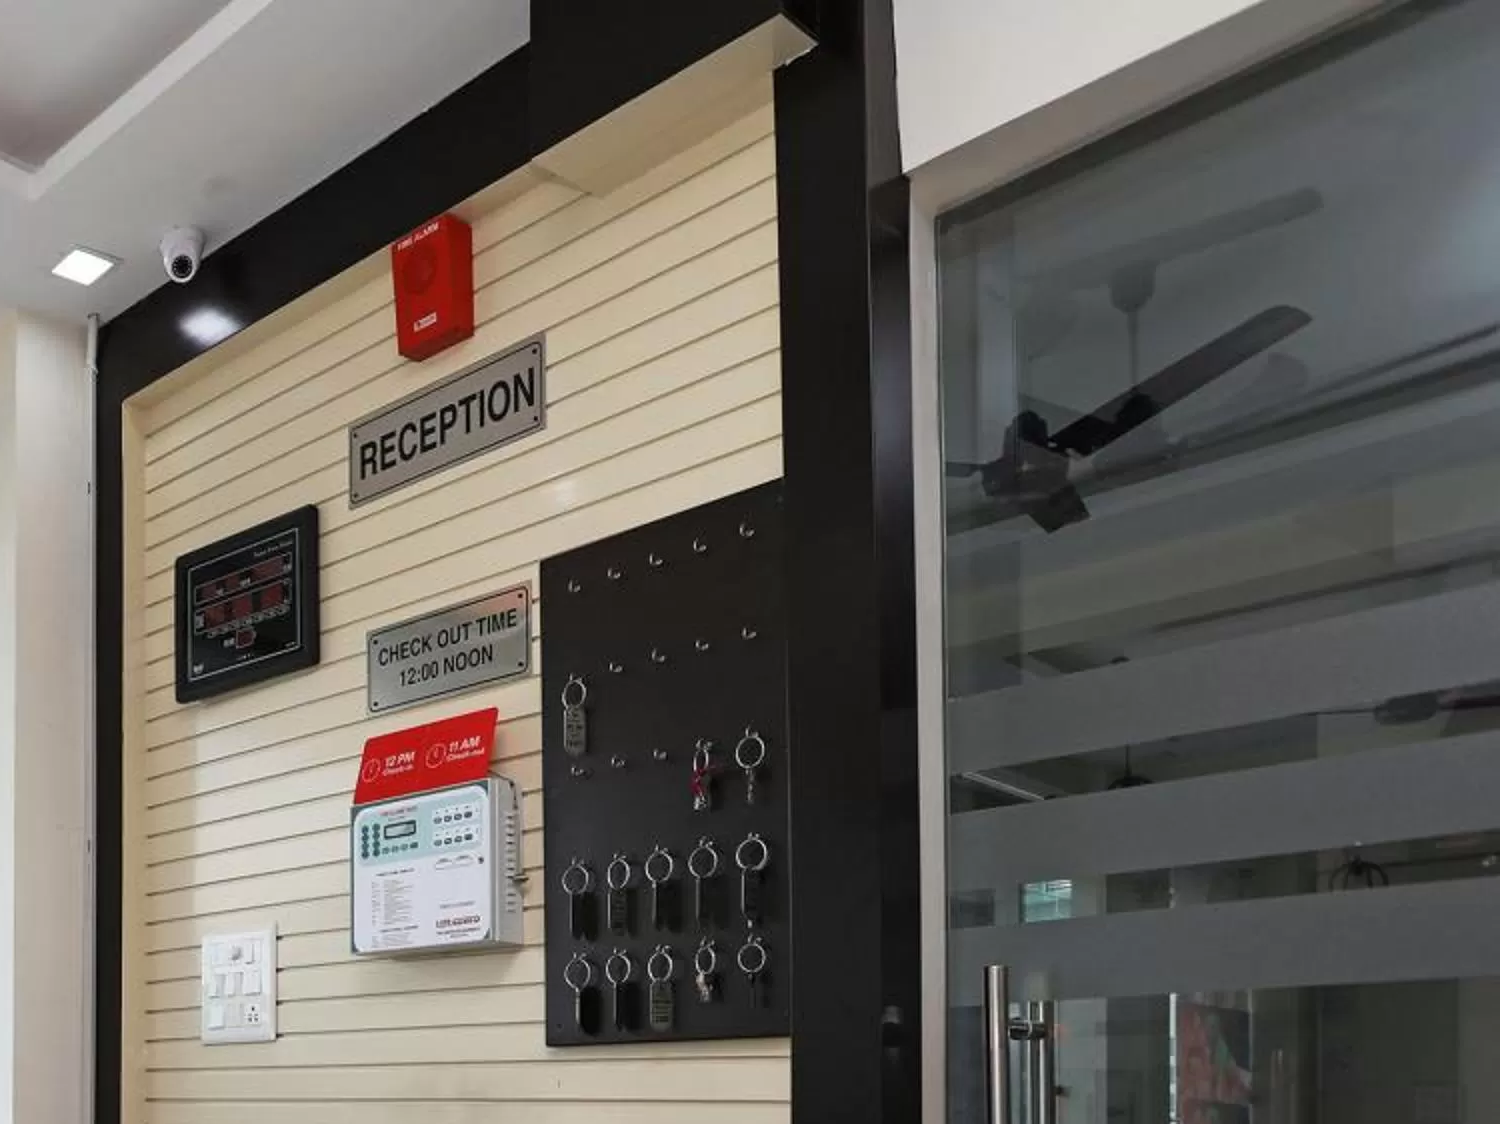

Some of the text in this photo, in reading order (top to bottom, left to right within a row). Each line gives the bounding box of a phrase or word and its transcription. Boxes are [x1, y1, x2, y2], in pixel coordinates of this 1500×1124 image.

[360, 367, 535, 480] RECEPTION
[378, 608, 517, 666] CHECK OUT TIME
[400, 644, 493, 686] 12:00 NOON
